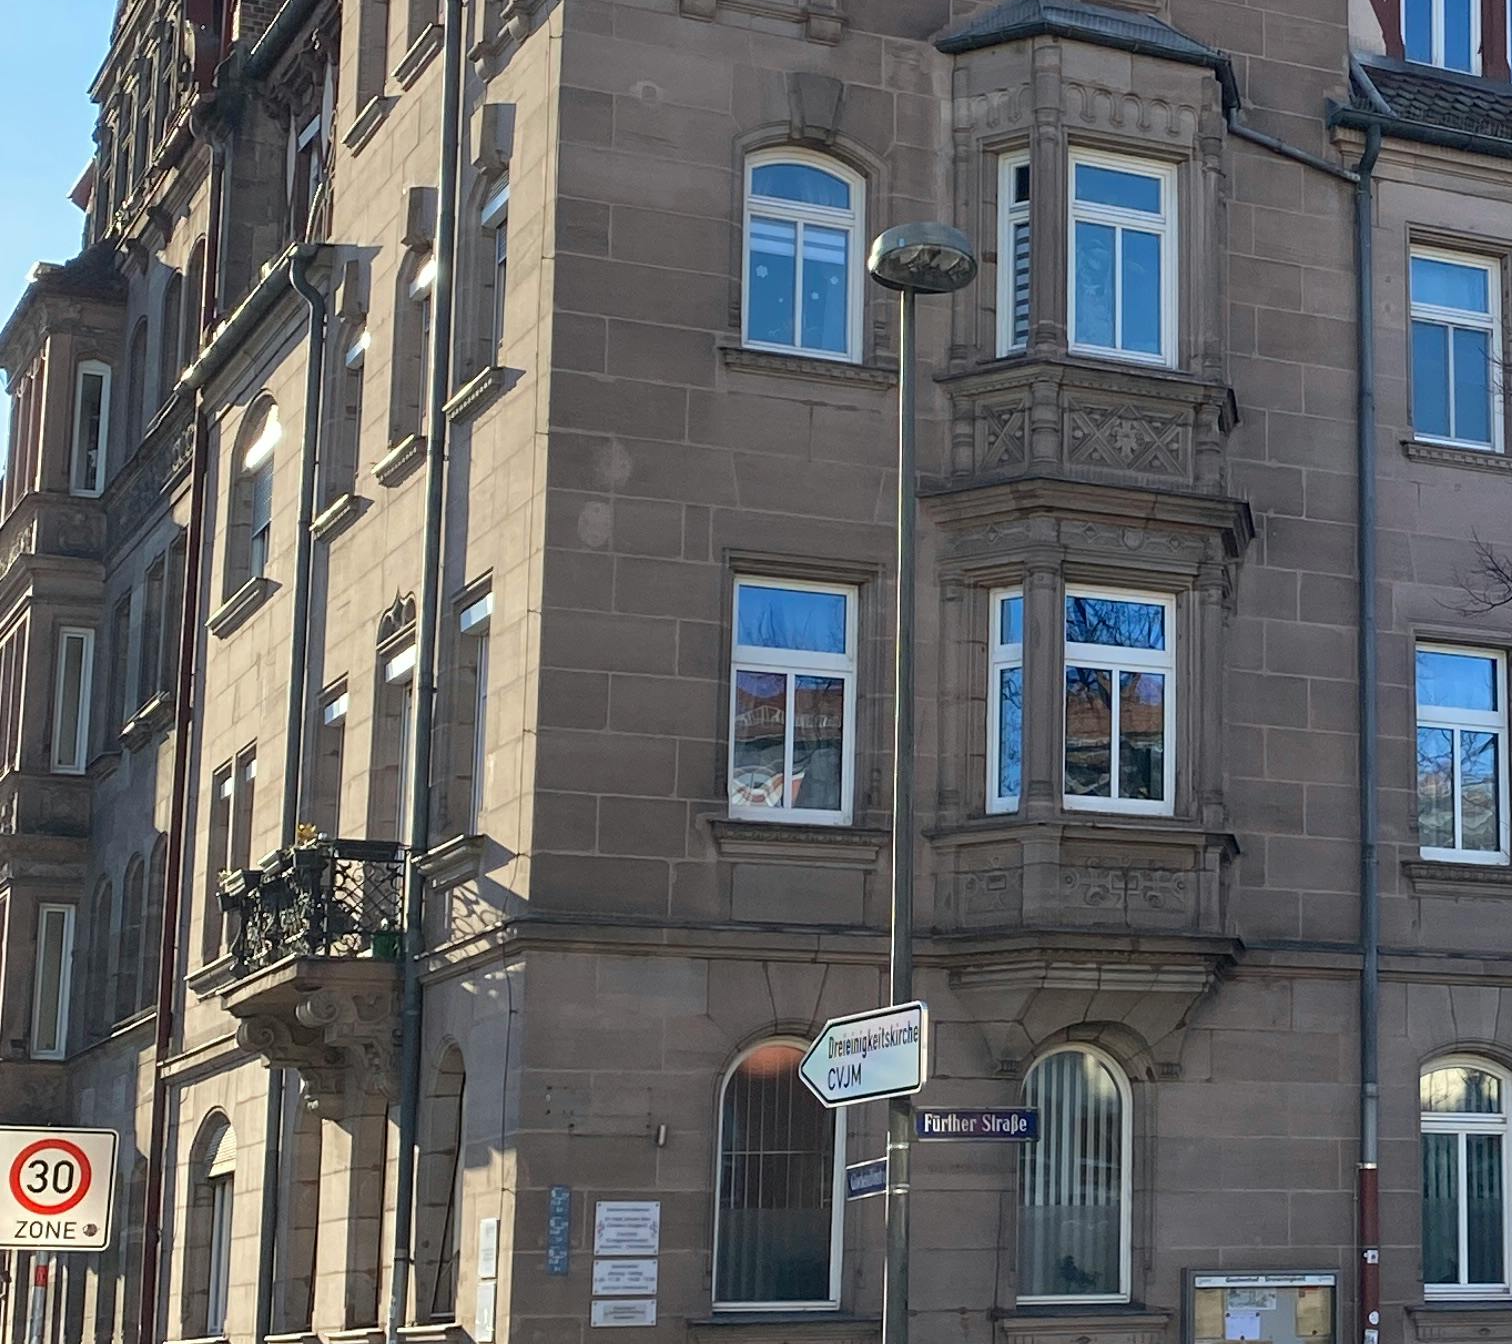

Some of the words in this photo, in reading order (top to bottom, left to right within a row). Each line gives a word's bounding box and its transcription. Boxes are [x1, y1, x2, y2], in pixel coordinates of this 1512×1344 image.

[828, 1020, 919, 1059] Dreieinigkeitskirche
[827, 1063, 862, 1091] CVJM
[924, 1113, 977, 1133] Fürther
[981, 1113, 1028, 1134] Straße
[26, 1159, 75, 1194] 30
[14, 1220, 77, 1239] ZONE
